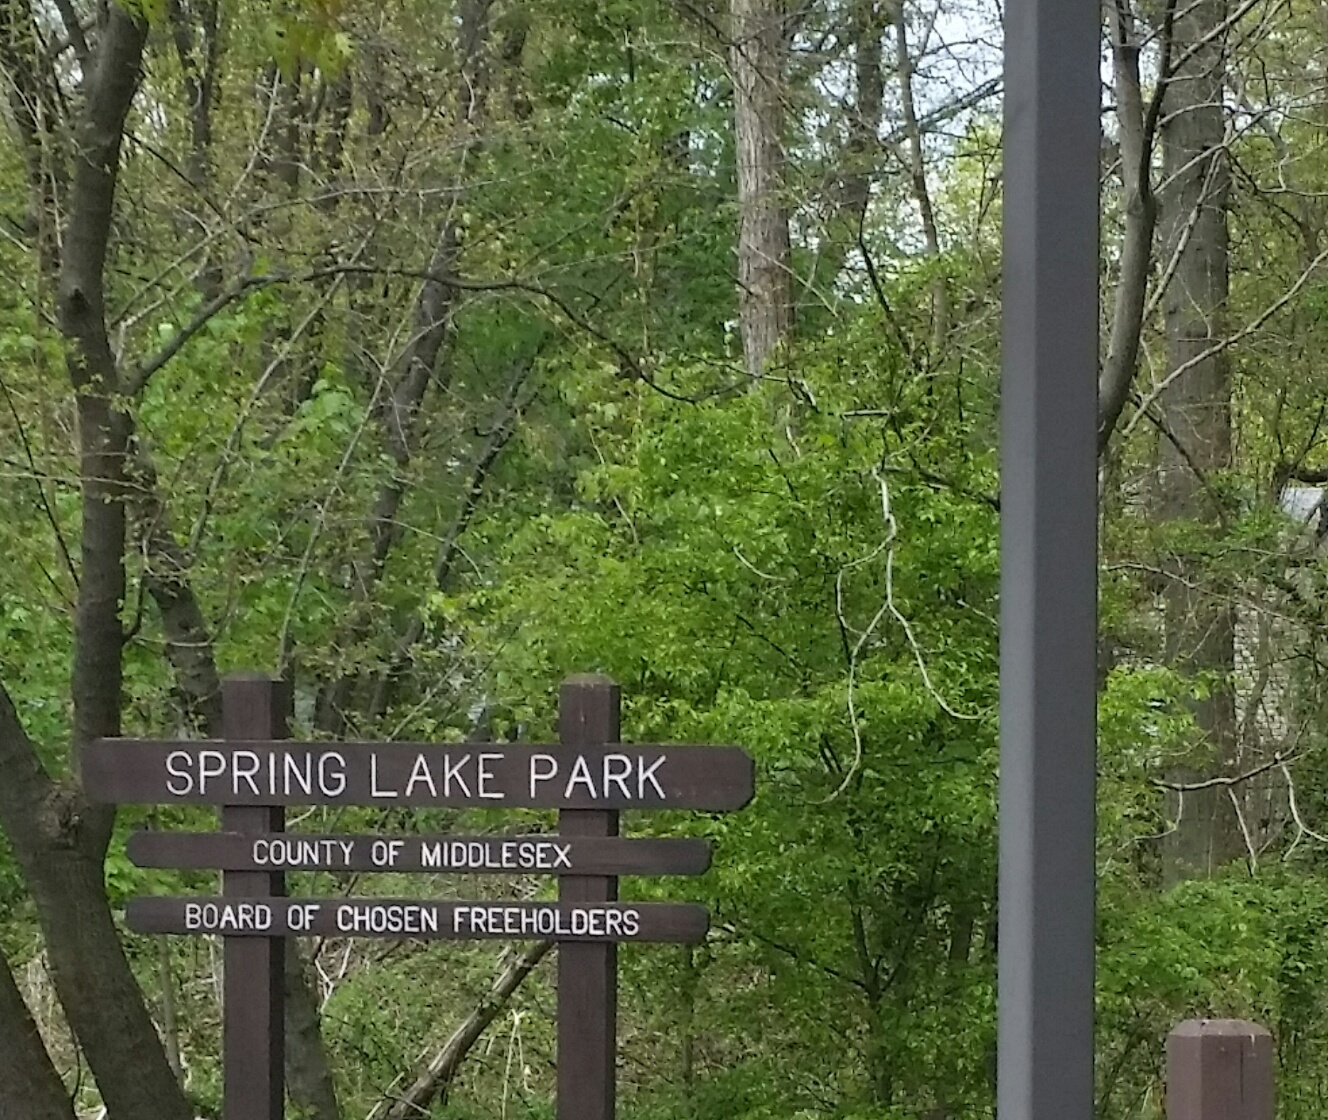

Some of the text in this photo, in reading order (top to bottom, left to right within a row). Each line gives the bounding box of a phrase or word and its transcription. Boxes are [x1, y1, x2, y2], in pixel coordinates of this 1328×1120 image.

[165, 750, 667, 799] SPRING LAKE PARK
[253, 839, 572, 869] COUNTY OF MIDDLESEX
[185, 902, 640, 936] BOARD OF CHOSEN FREEHOLDERS
